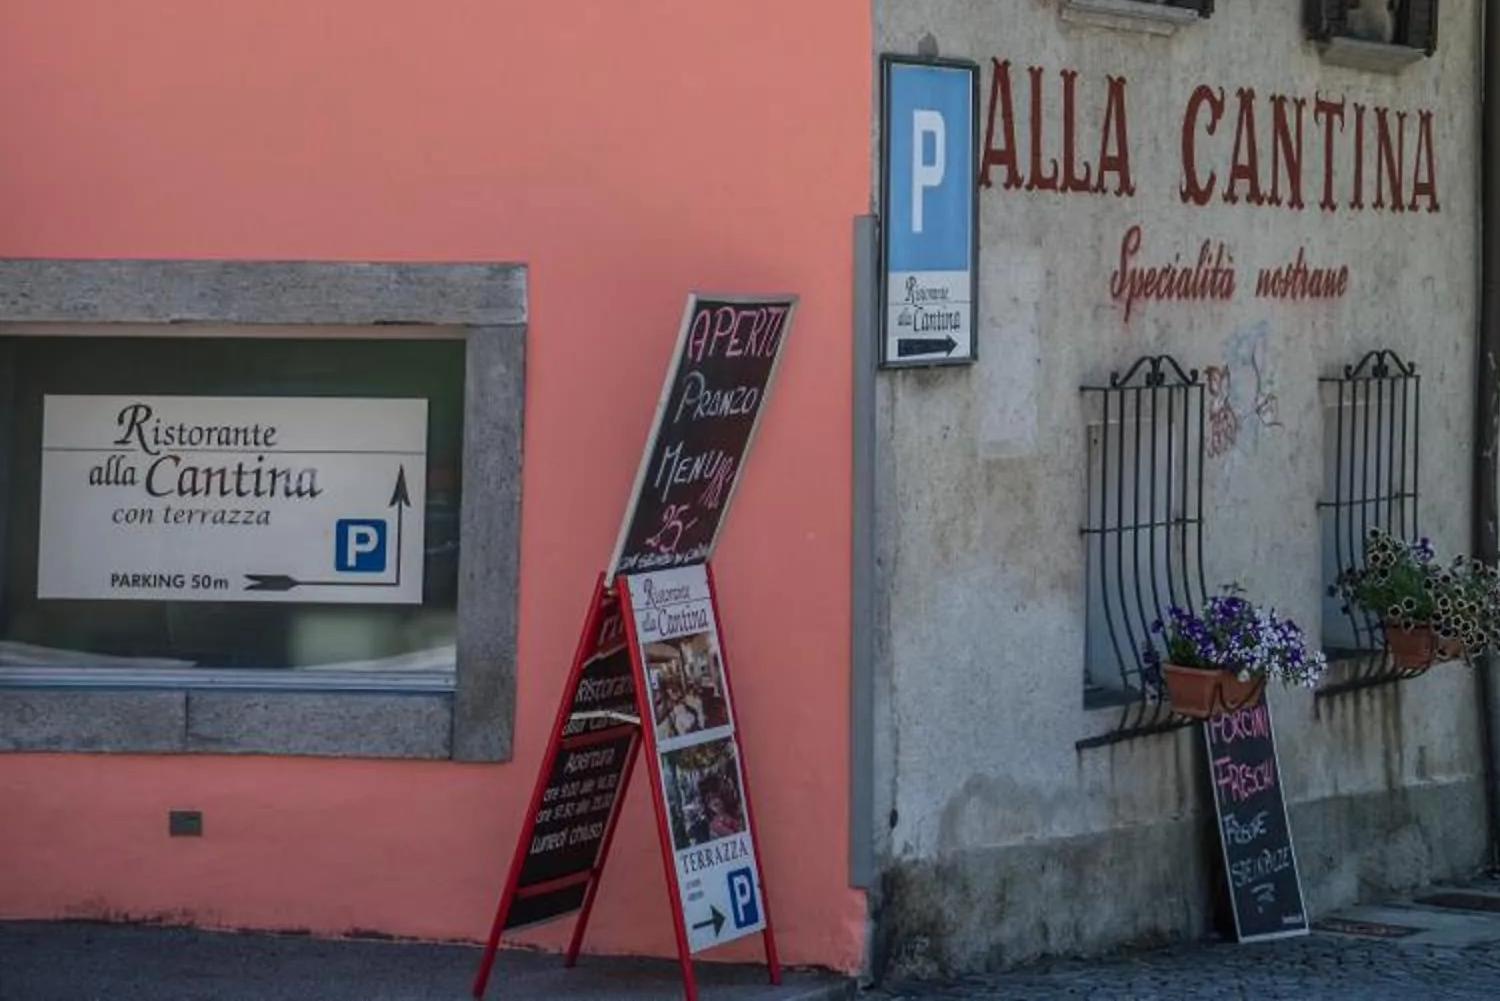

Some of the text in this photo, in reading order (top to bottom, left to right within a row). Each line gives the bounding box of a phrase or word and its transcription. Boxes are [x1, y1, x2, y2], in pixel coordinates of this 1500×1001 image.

[978, 56, 1440, 212] ALLA CANTINA
[911, 109, 946, 234] P
[1110, 225, 1348, 323] Specialità nostrane
[914, 305, 961, 332] Cantina
[113, 404, 277, 455] Ristorante
[89, 455, 322, 498] alla Cantina
[112, 503, 271, 526] con terrazza
[346, 525, 379, 567] P
[110, 573, 186, 590] PARKING
[658, 604, 708, 634] Cantina
[683, 838, 748, 875] TERRAZZA
[733, 875, 751, 923] P
